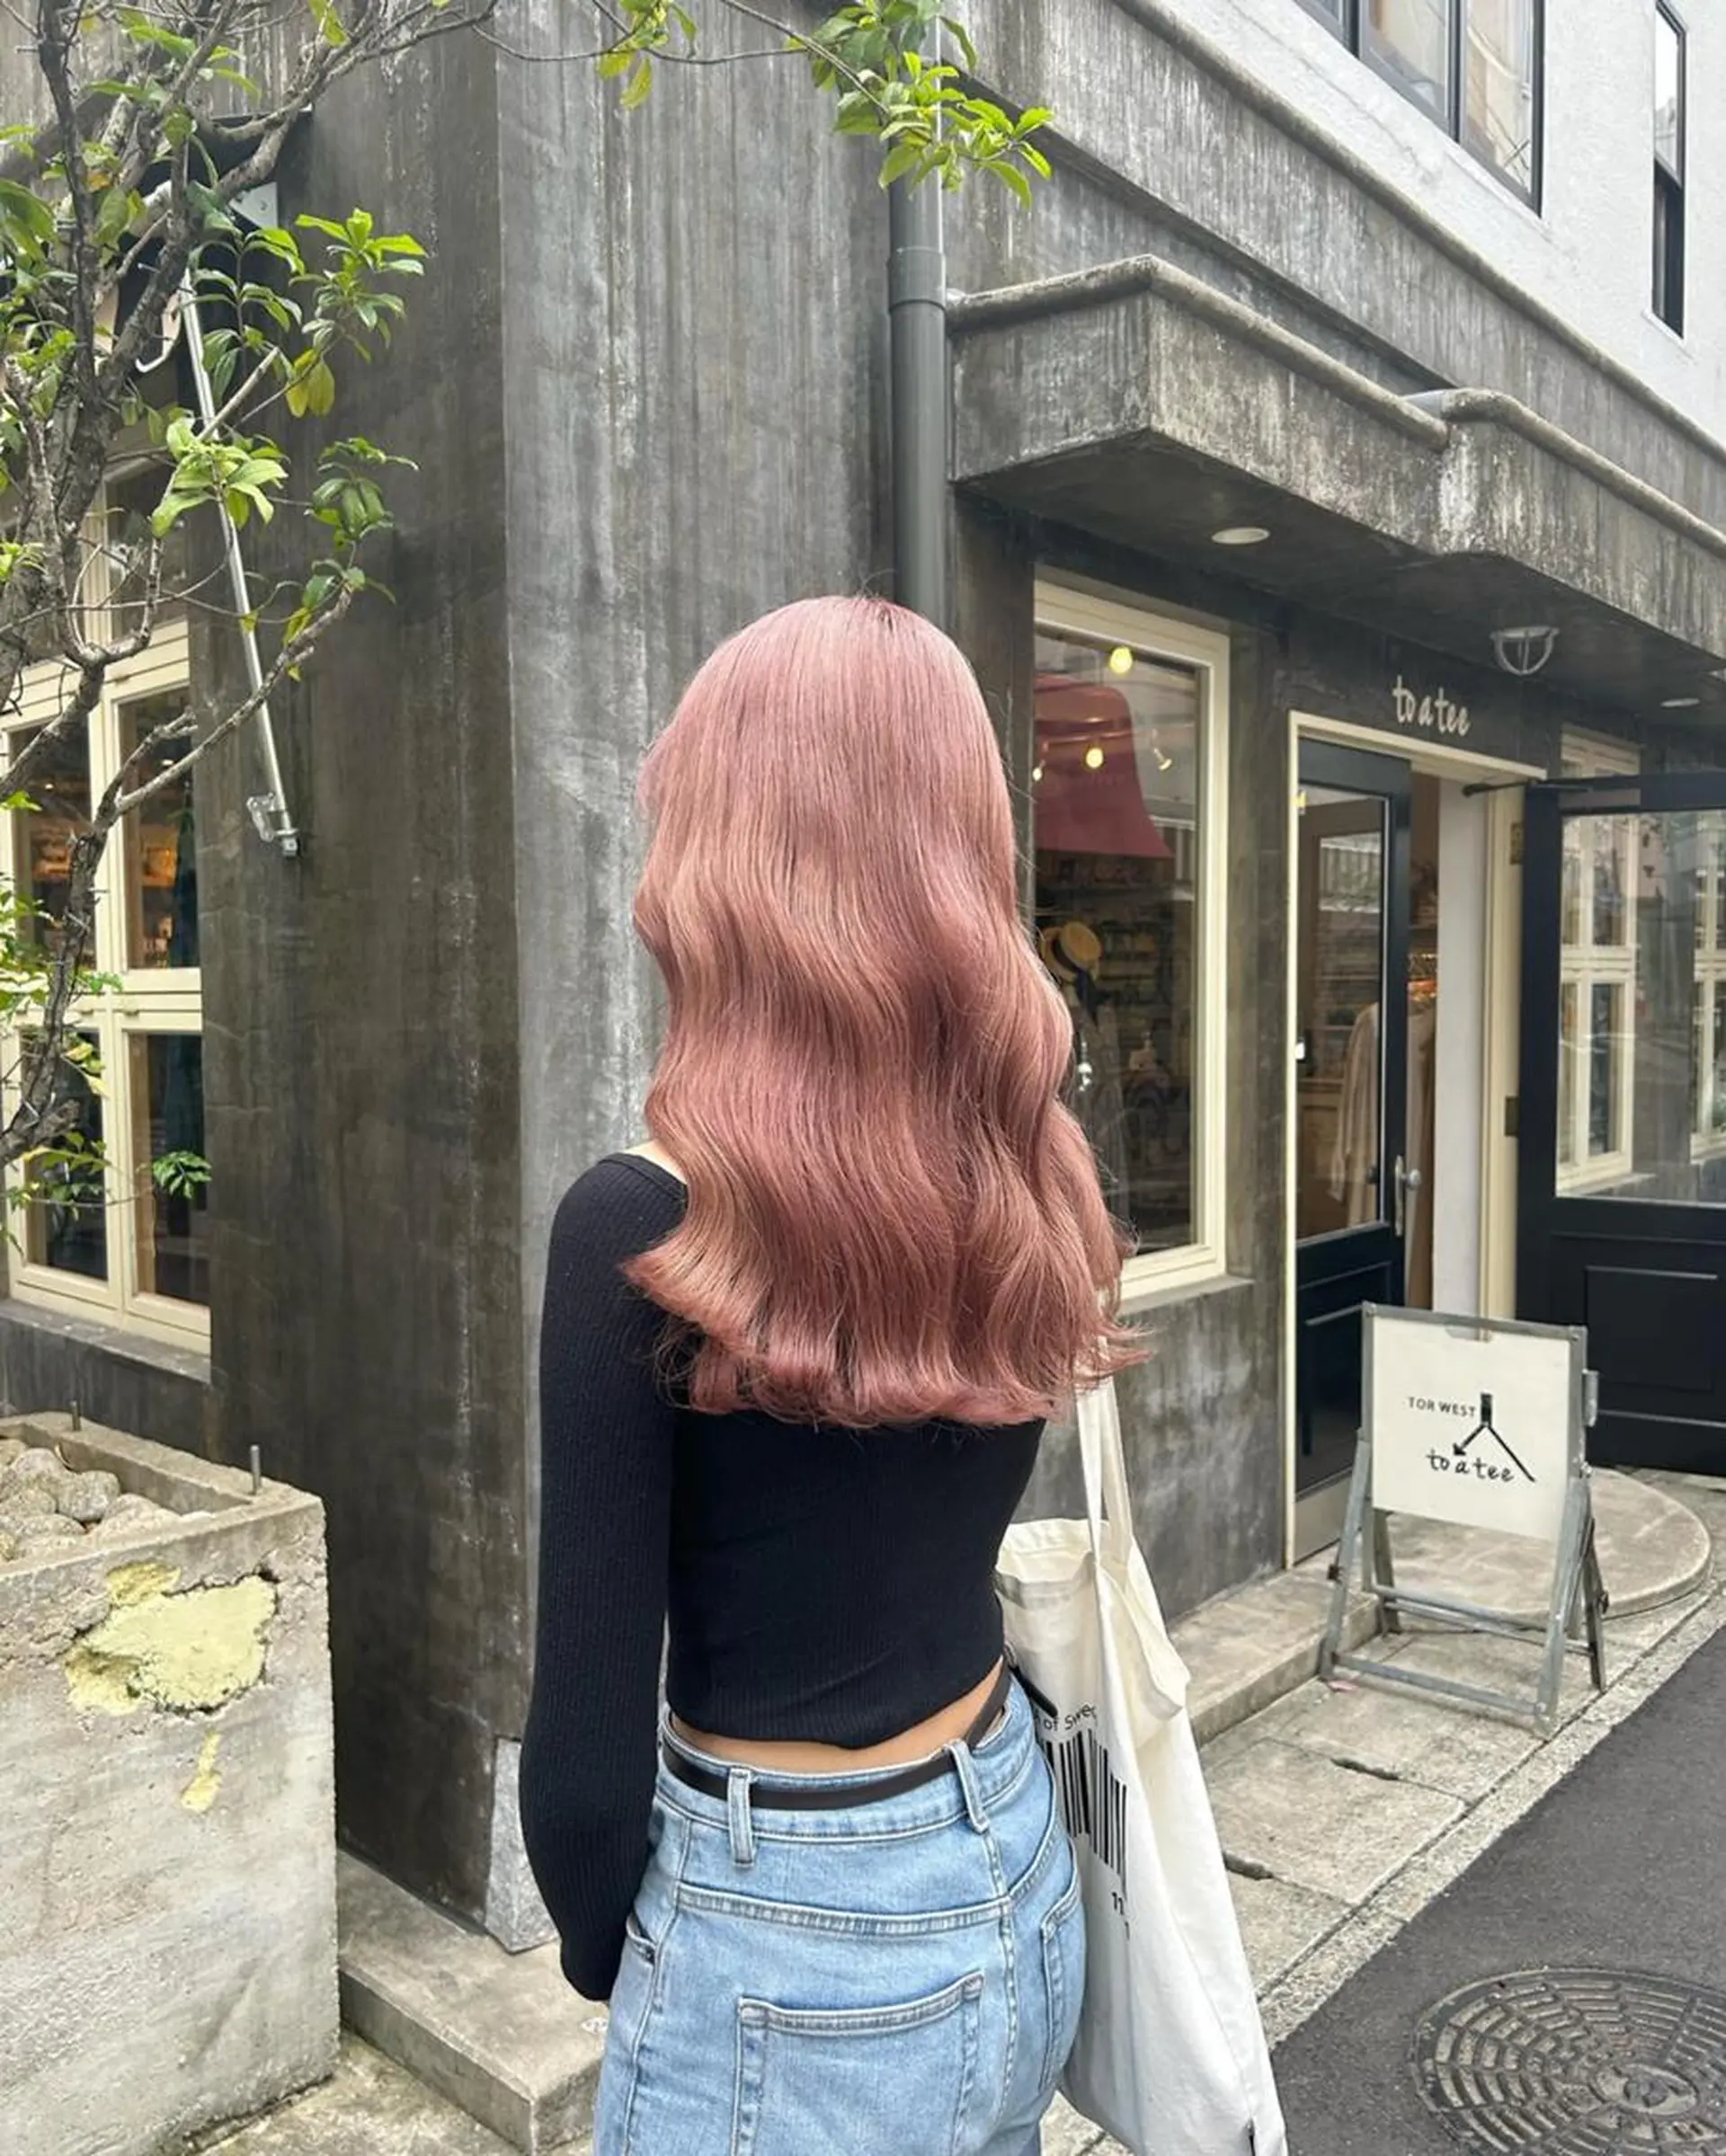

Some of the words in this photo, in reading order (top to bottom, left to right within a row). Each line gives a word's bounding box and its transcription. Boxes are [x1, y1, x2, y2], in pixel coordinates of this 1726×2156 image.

[1408, 1397, 1435, 1412] TOR
[1438, 1400, 1475, 1417] WEST
[1426, 1448, 1450, 1471] to
[1455, 1460, 1470, 1474] a
[1472, 1457, 1514, 1483] tee
